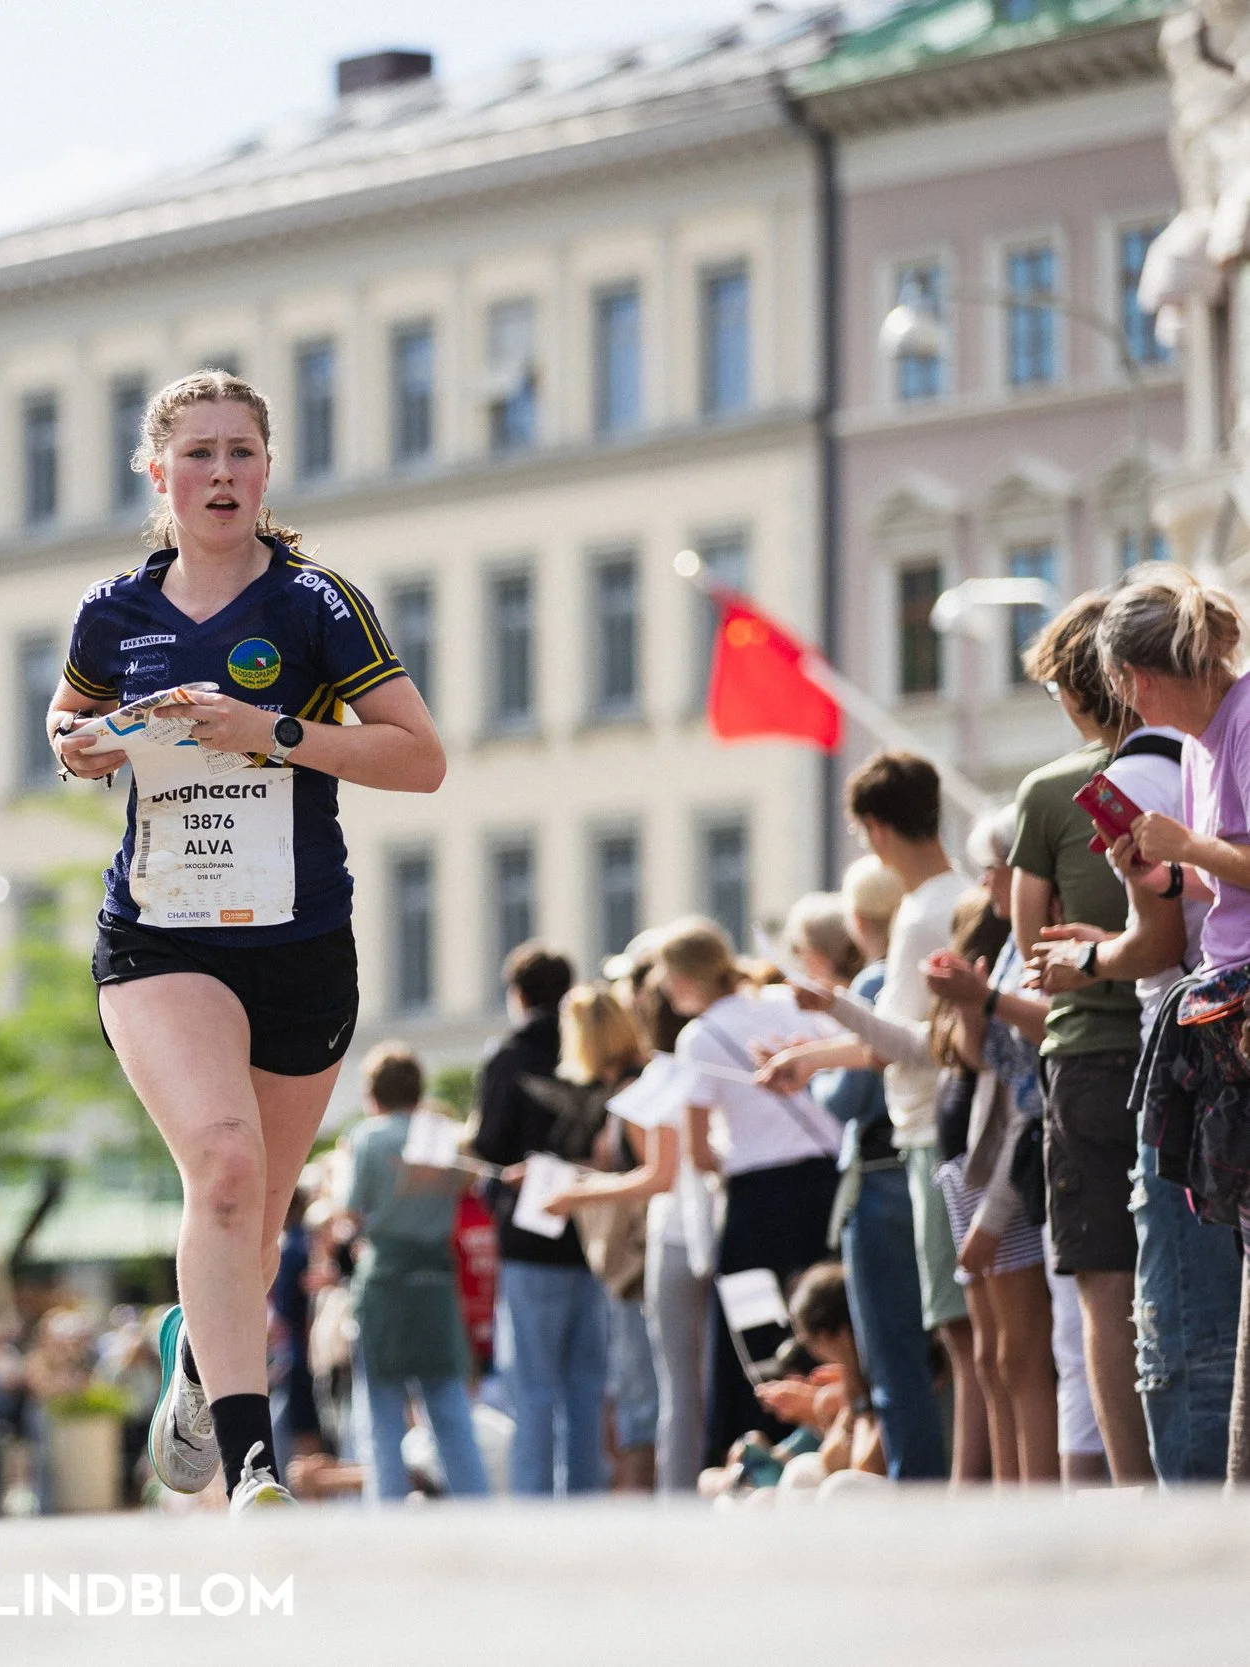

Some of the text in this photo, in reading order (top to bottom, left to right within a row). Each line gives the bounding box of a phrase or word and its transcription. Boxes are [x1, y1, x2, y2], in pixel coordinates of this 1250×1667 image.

[182, 814, 235, 829] 13876
[184, 839, 234, 855] ALVA
[167, 911, 211, 919] CHALMERS
